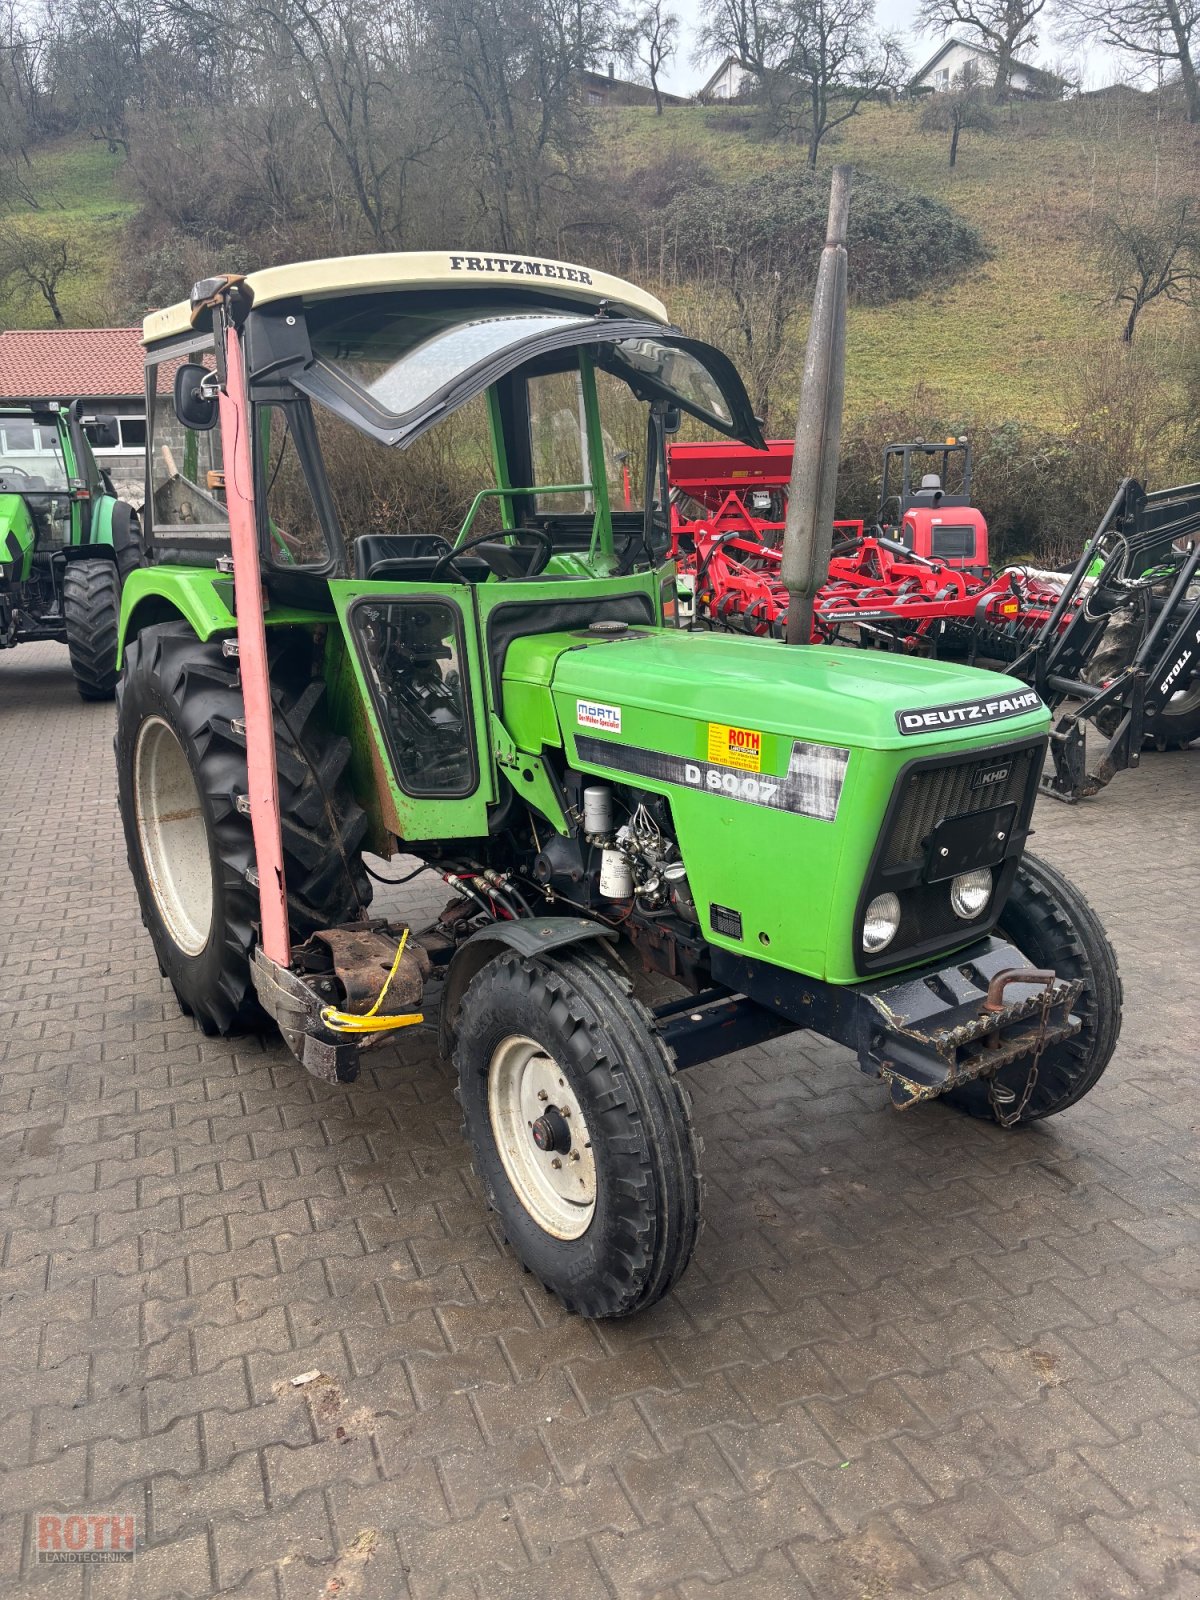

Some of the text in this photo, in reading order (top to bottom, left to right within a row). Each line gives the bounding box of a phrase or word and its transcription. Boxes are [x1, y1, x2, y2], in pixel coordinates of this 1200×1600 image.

[449, 256, 593, 286] FRITZMEIER
[1160, 649, 1192, 695] STOLL
[903, 692, 1039, 728] DEUTZ-FAHR
[728, 728, 760, 750] ROTH
[684, 764, 778, 802] D 6007
[981, 769, 1009, 785] KHD
